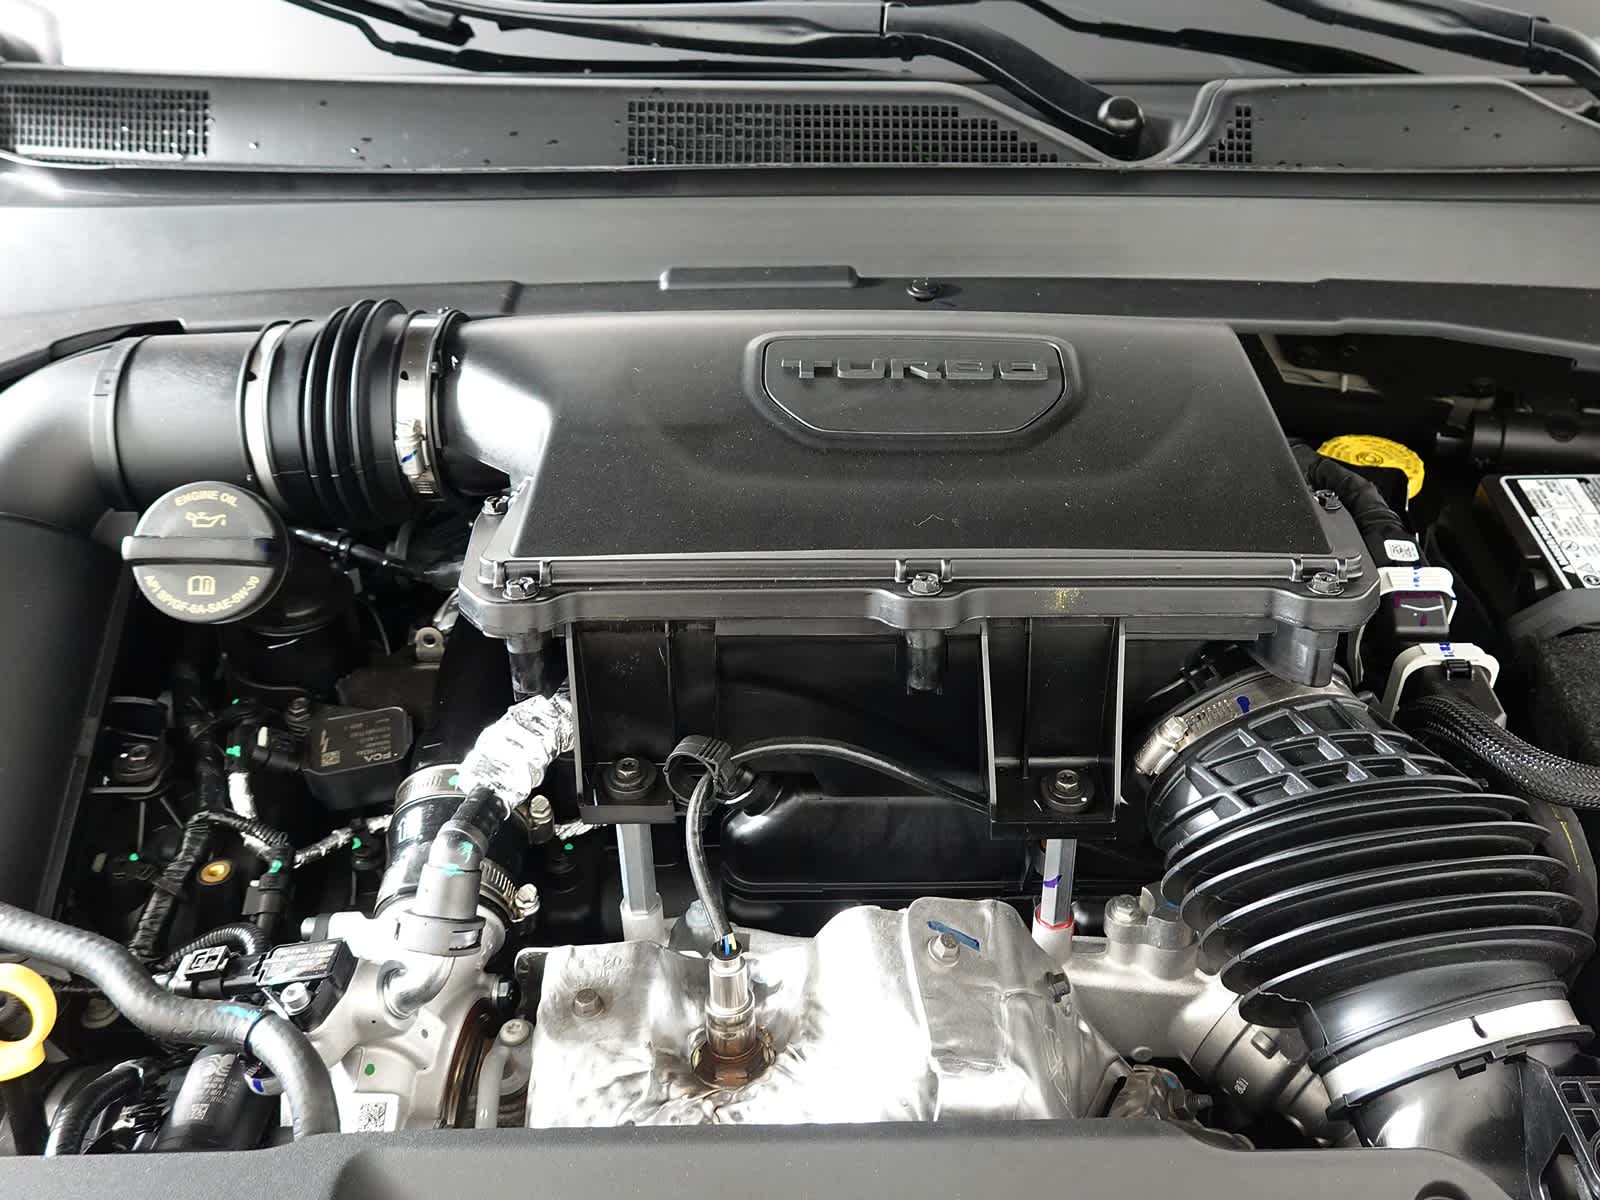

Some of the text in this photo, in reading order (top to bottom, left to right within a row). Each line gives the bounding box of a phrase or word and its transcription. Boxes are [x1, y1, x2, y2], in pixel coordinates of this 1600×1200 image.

[781, 359, 1049, 381] TURBO
[174, 490, 239, 508] ENGINE OIL
[363, 751, 392, 763] FCA
